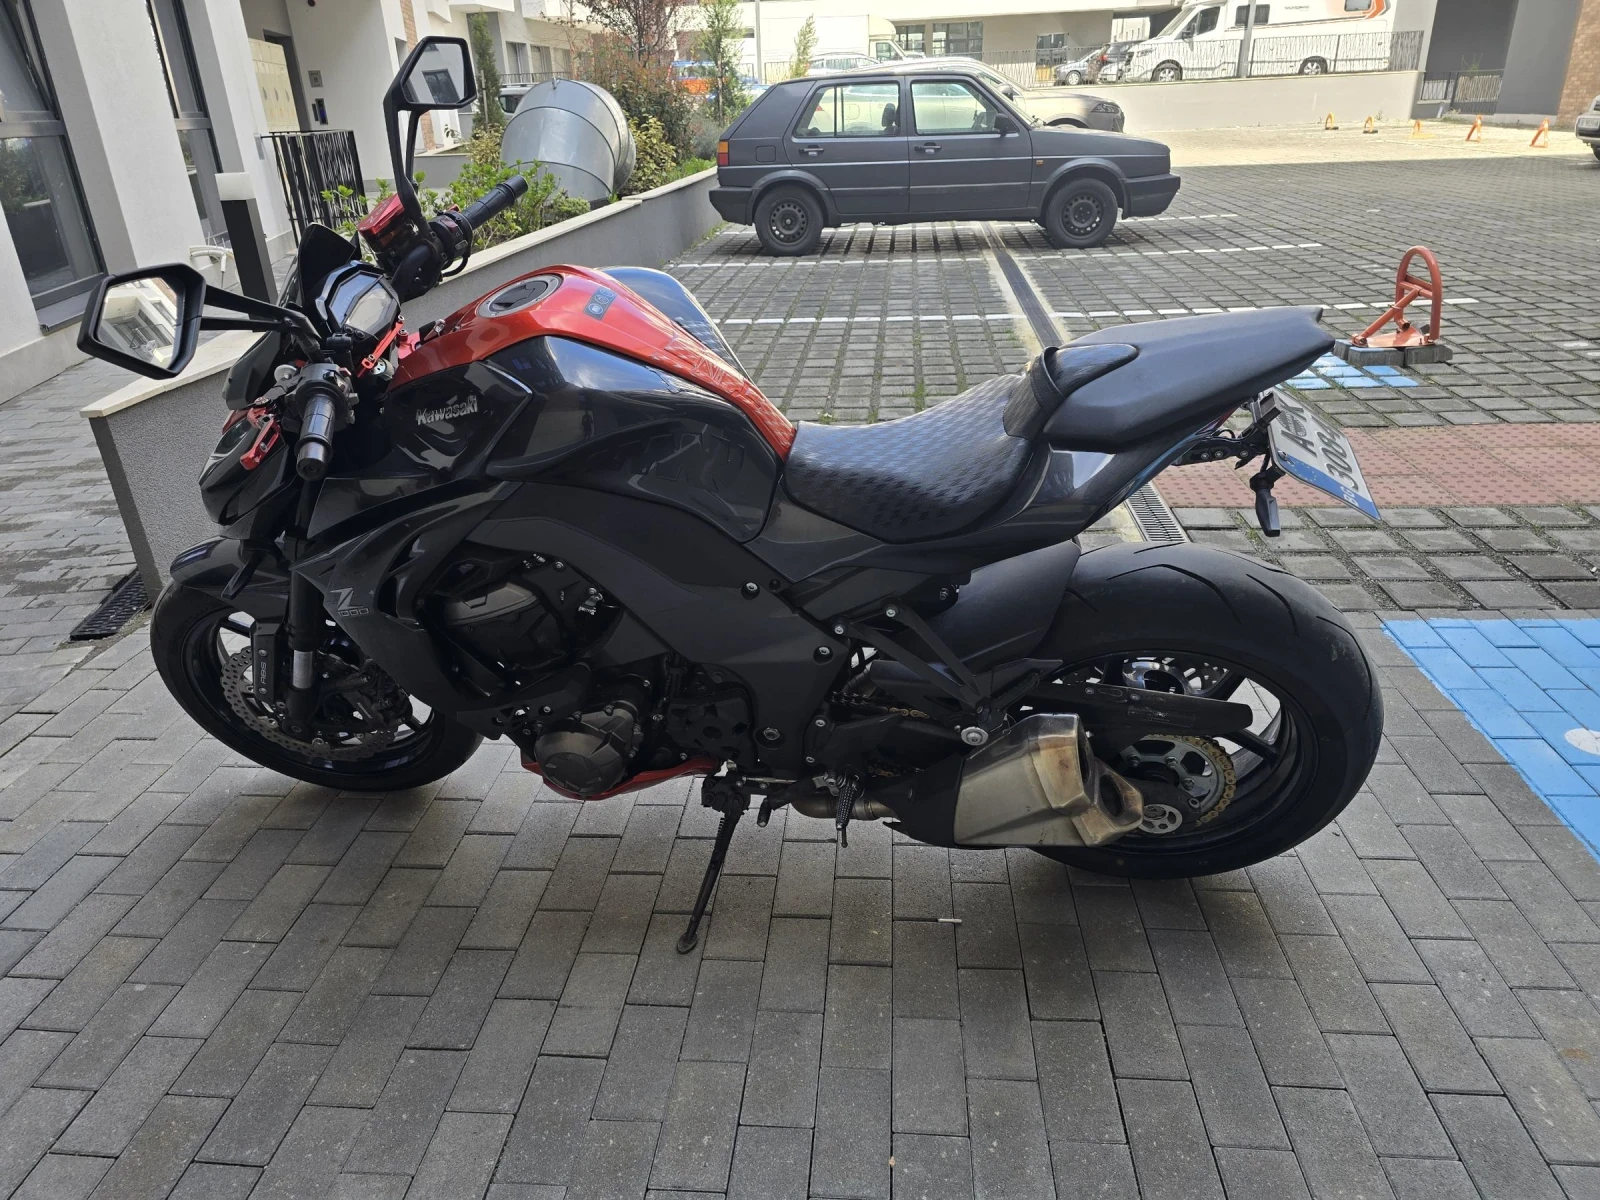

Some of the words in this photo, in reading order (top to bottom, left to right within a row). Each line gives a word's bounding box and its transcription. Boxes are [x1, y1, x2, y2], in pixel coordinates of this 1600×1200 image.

[416, 395, 478, 426] Kawasaki
[1311, 414, 1359, 492] 3084
[1340, 485, 1359, 508] BG
[330, 587, 364, 611] Z
[337, 608, 369, 617] 1000
